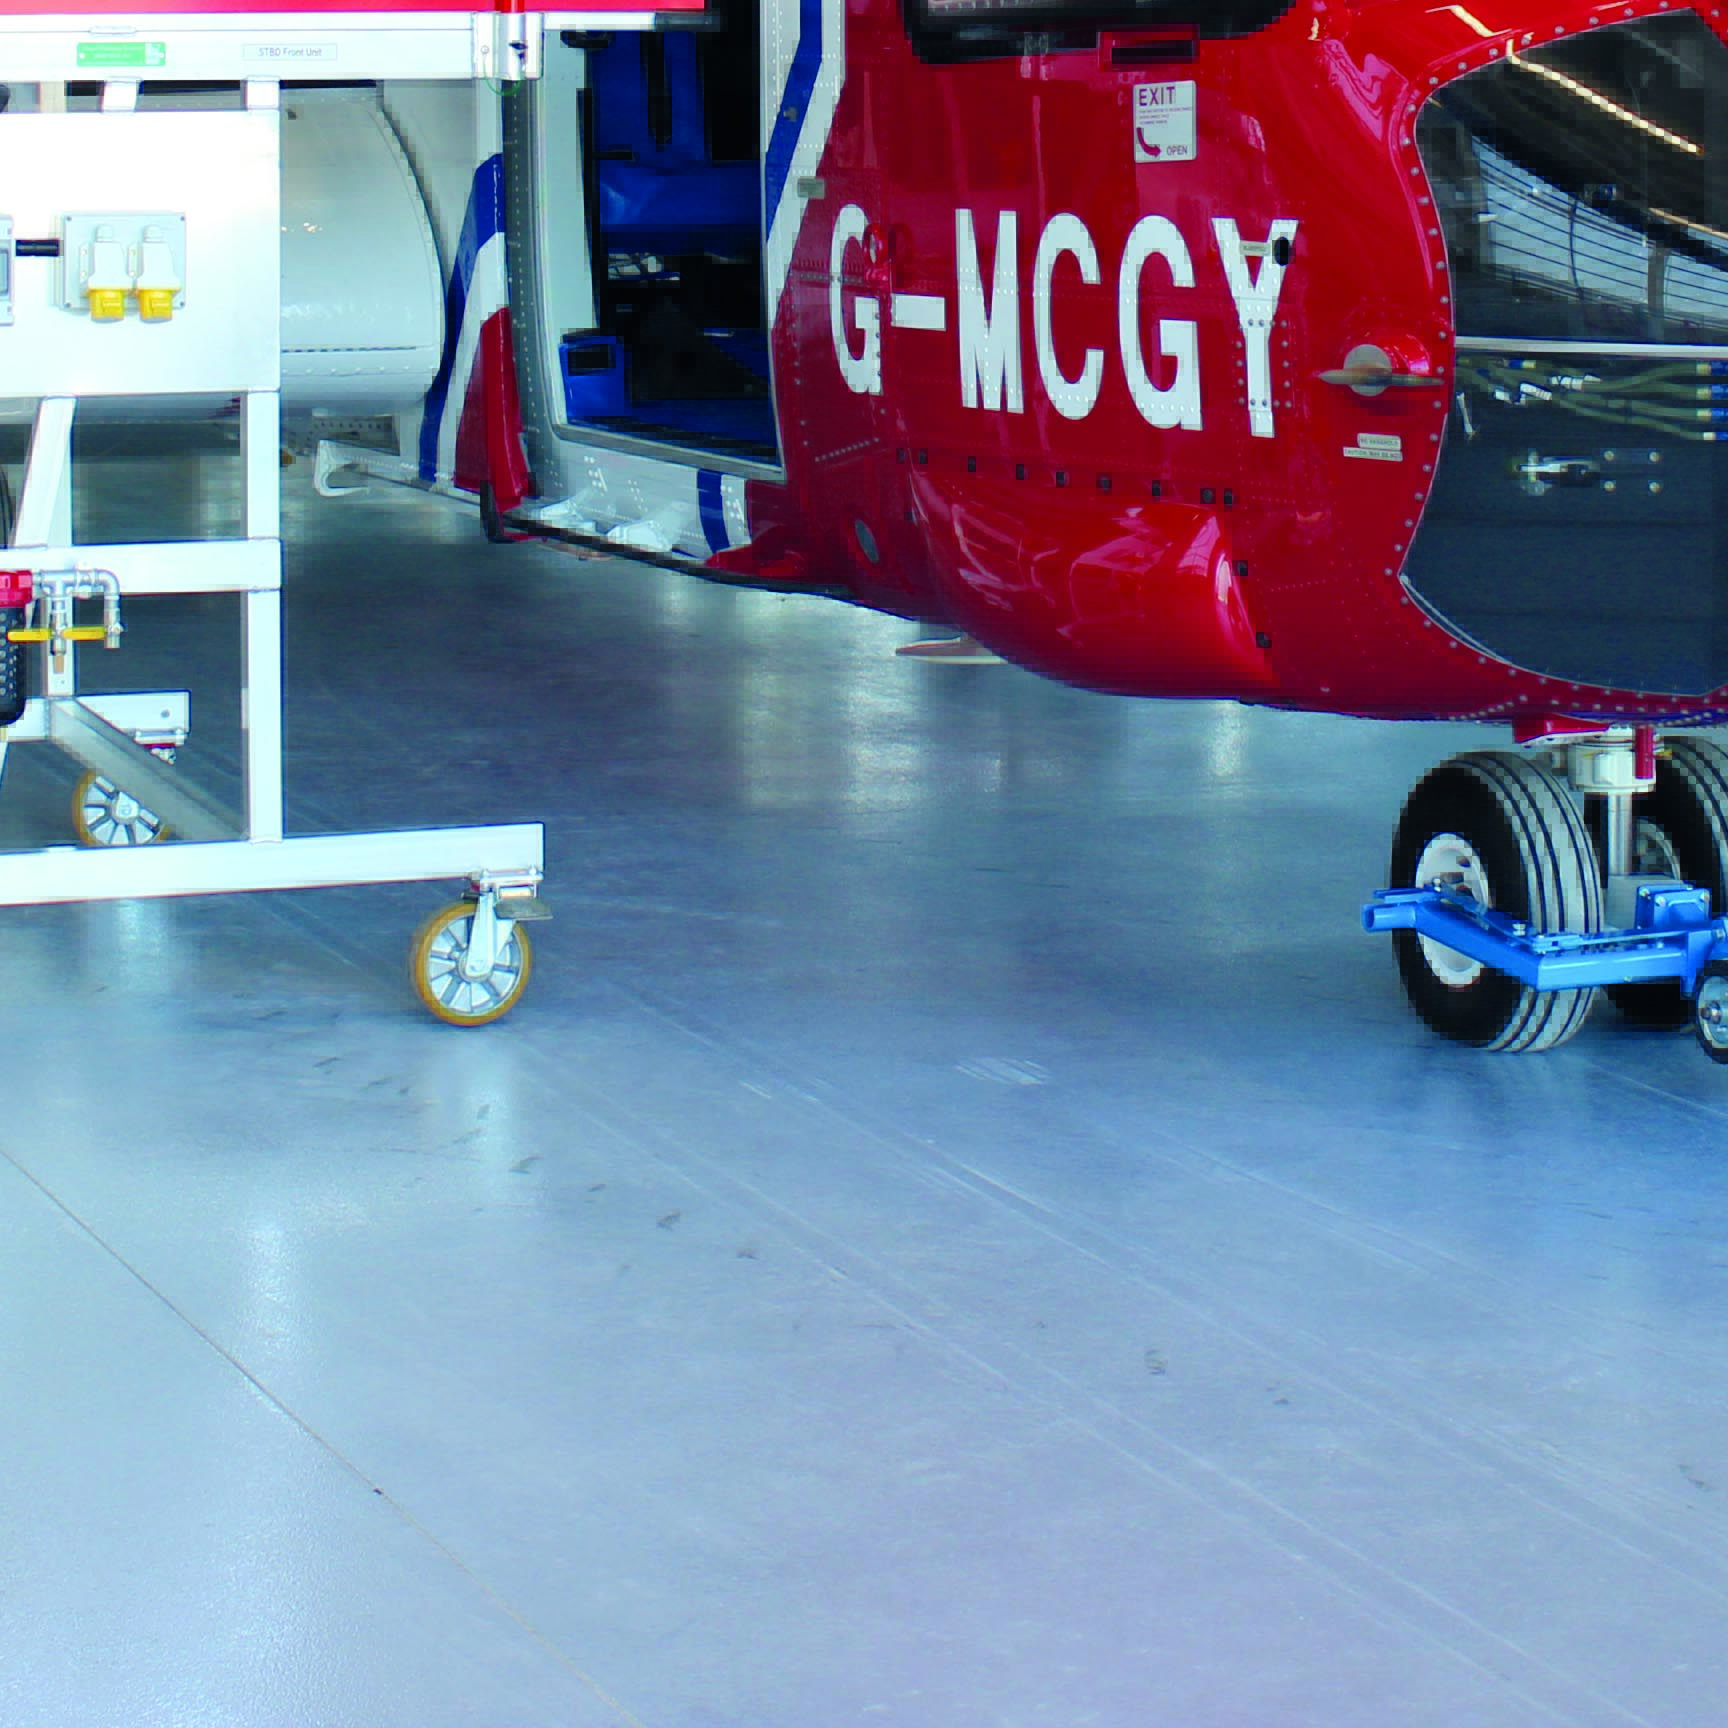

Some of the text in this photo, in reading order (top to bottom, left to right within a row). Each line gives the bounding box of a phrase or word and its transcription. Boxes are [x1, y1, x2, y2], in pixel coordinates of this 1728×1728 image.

[1139, 86, 1175, 106] EXIT
[1167, 145, 1188, 156] OPEN
[829, 203, 1299, 438] G-MCGY
